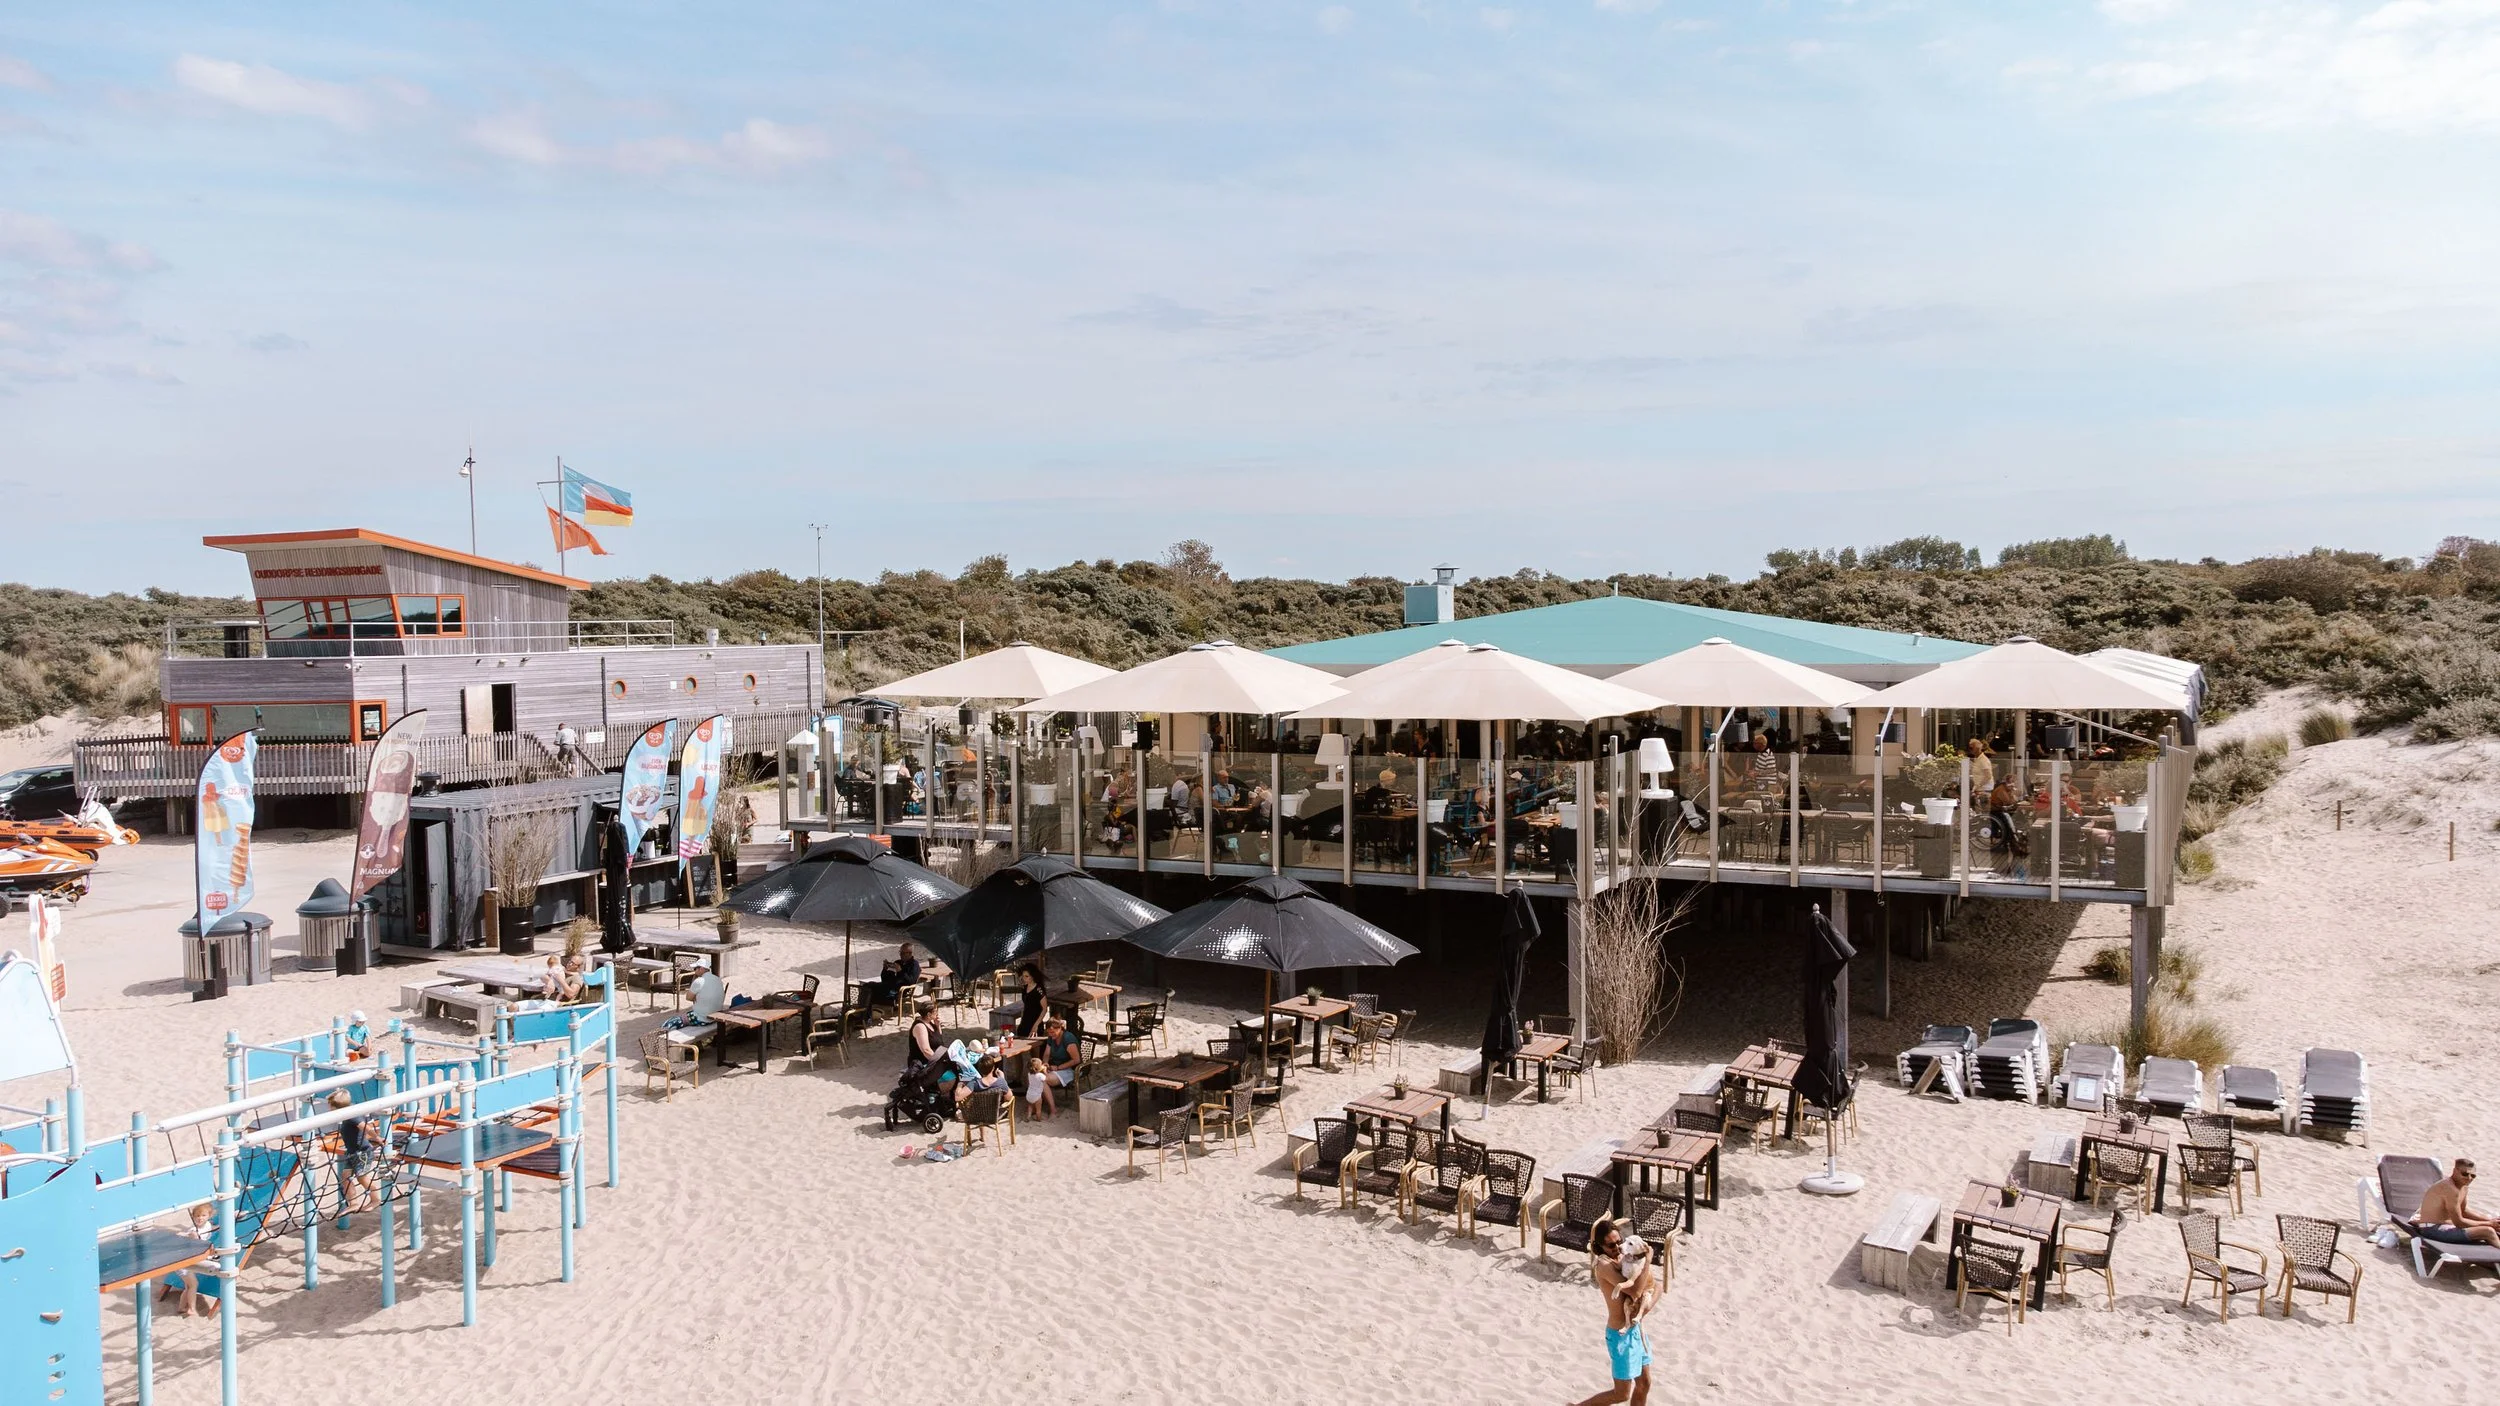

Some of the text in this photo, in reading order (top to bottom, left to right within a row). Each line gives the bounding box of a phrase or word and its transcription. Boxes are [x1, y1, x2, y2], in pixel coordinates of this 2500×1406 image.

[254, 565, 383, 579] OUDDORPSE REDDINGSBRIGADE
[397, 732, 412, 740] NEW
[360, 867, 399, 876] MAGNUM
